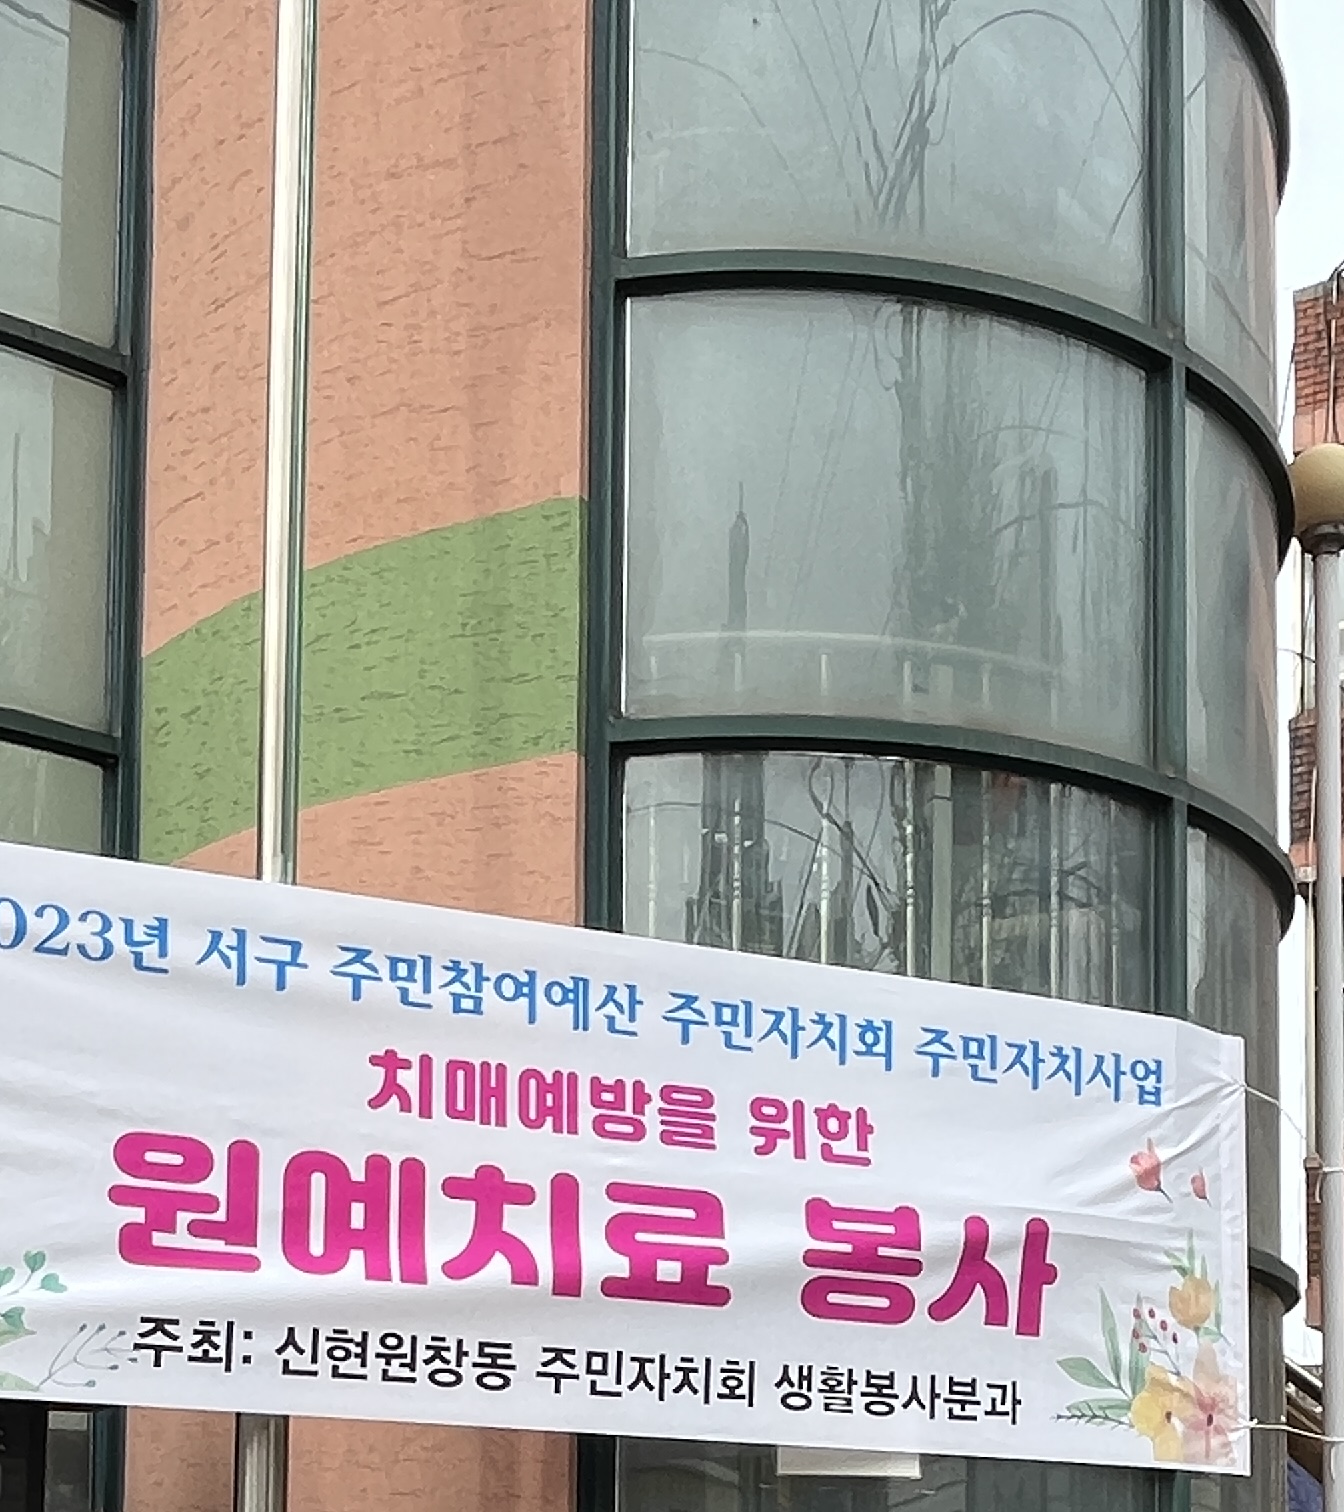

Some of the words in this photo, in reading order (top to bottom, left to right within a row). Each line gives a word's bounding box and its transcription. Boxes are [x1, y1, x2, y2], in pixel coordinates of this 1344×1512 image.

[197, 927, 308, 992] 서구
[331, 947, 643, 1036] 주민참여예산
[662, 991, 894, 1071] 주민자치회
[915, 1026, 1163, 1107] 주민자치사업
[368, 1049, 715, 1150] 치매예방을
[749, 1097, 874, 1166] 위한
[108, 1131, 731, 1308] 원예치료
[800, 1196, 1058, 1337] 봉사
[132, 1315, 254, 1373] 주최:
[274, 1326, 517, 1392] 신현원창동
[534, 1346, 757, 1408] 주민자치회
[773, 1364, 1023, 1426] 생활봉사분과
